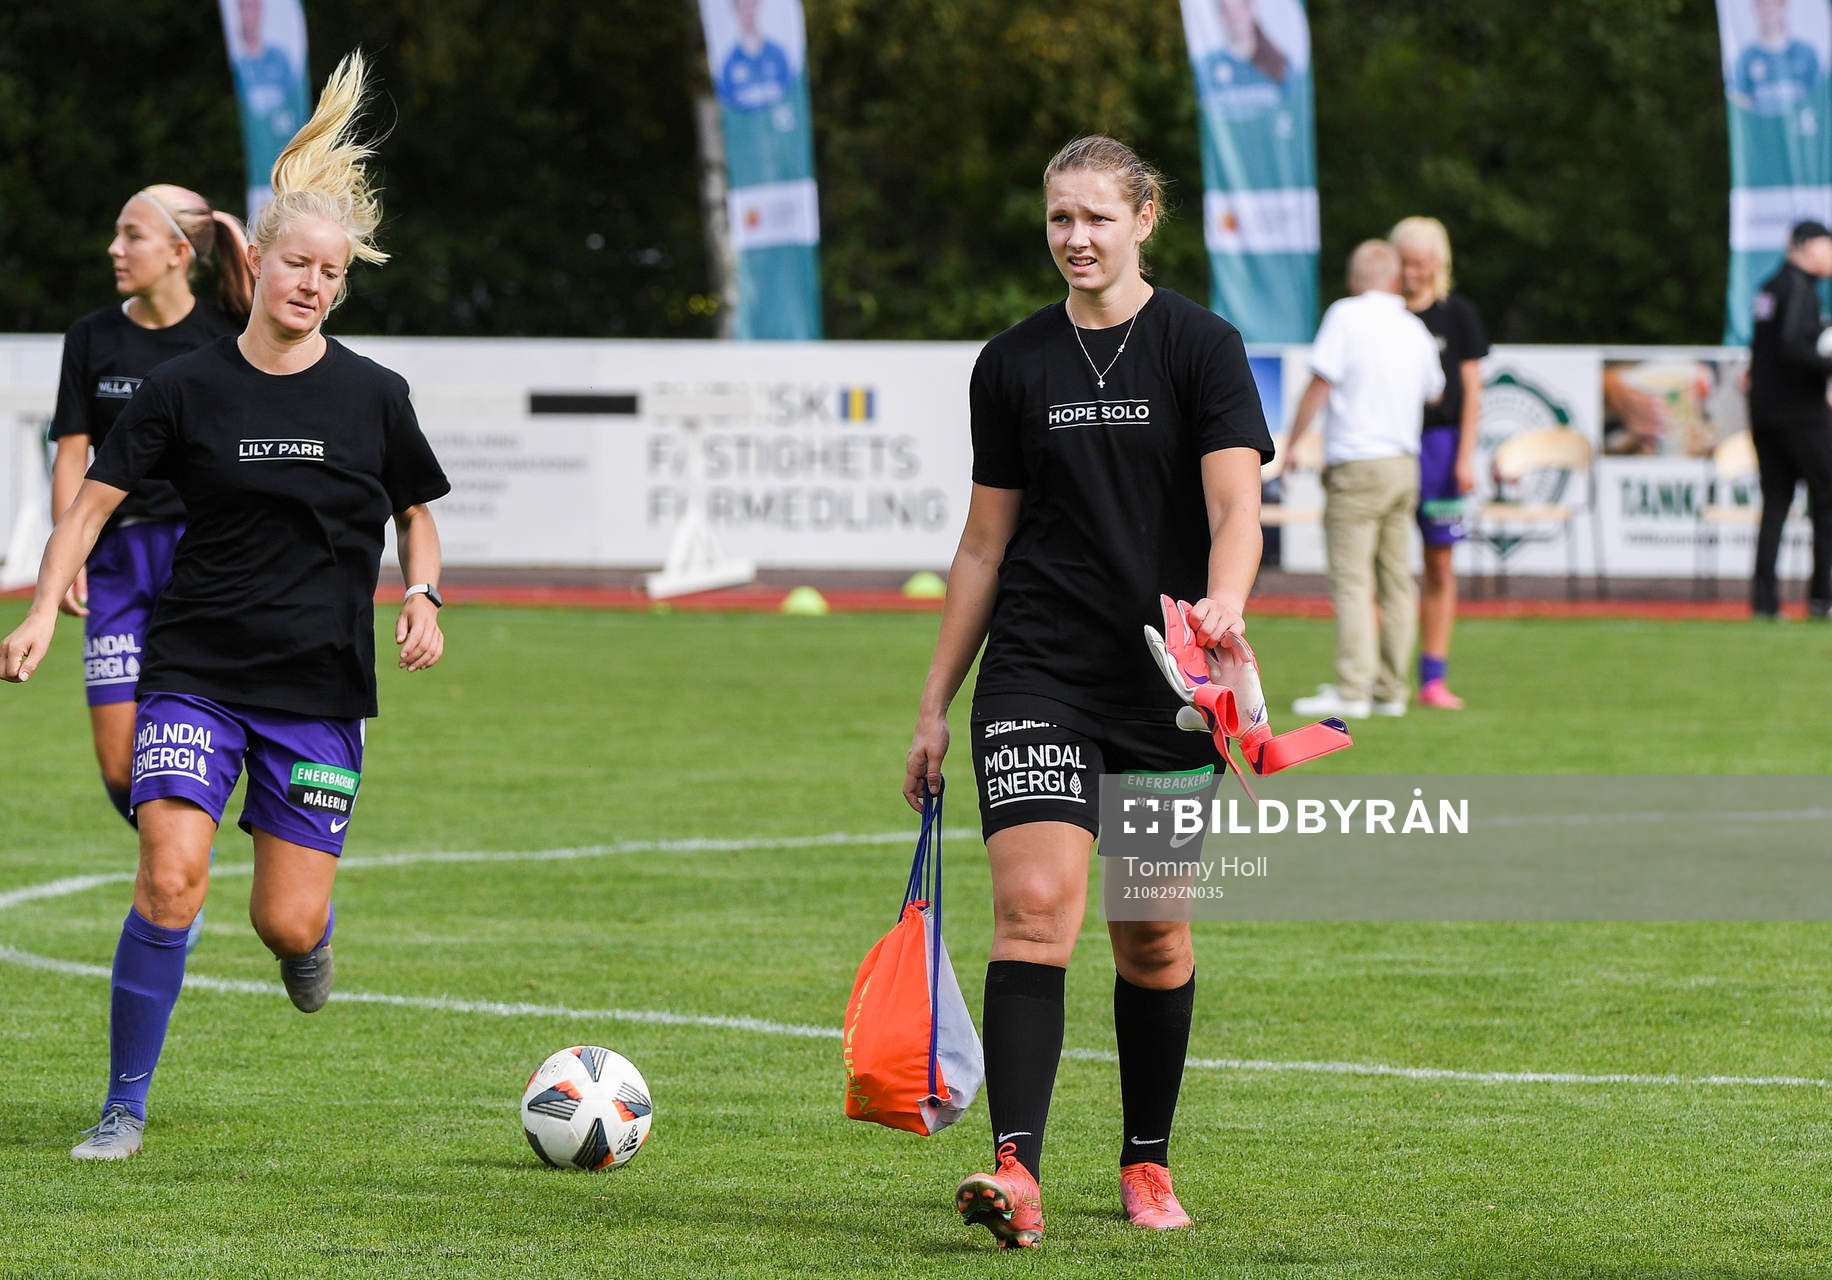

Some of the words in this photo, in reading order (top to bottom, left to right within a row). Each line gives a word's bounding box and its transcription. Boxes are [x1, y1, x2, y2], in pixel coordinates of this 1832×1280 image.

[1049, 407, 1097, 424] HOPE
[1101, 405, 1150, 419] SOLO
[239, 443, 274, 456] LILY
[278, 443, 324, 456] PARR
[84, 633, 142, 658] LNDAL
[85, 656, 125, 681] ERGI
[136, 722, 215, 754] MÖLNDAL
[136, 747, 195, 776] ENERGI
[985, 744, 1087, 776] MÖLNDAL
[987, 770, 1066, 801] ENERGI
[1127, 771, 1211, 790] ENERBACKENS
